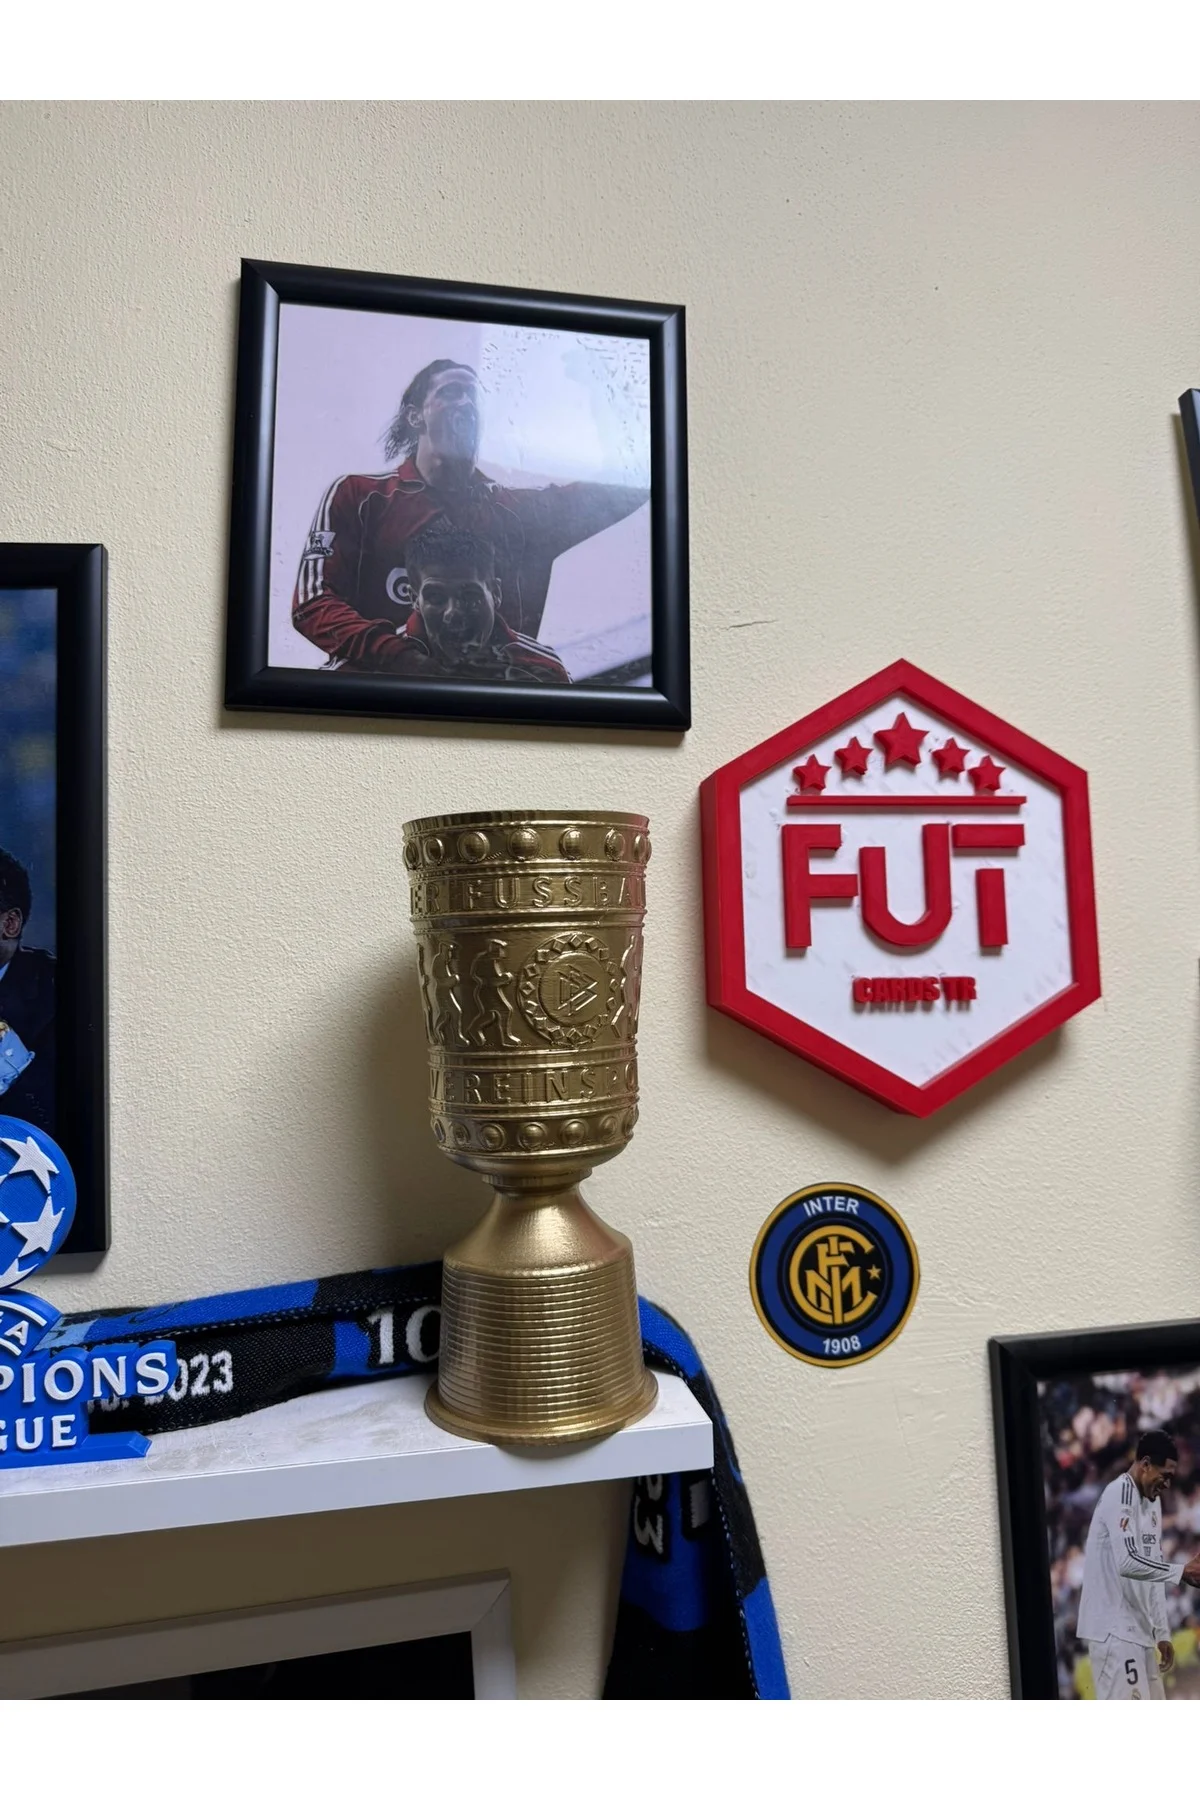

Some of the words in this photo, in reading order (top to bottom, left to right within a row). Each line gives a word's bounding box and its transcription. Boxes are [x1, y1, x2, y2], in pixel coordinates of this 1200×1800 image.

[782, 823, 1026, 949] FUT
[852, 976, 941, 1003] CARDS
[803, 1195, 860, 1218] INTER
[0, 1310, 30, 1346] A
[822, 1334, 862, 1355] 1908
[1124, 1658, 1139, 1686] 5
